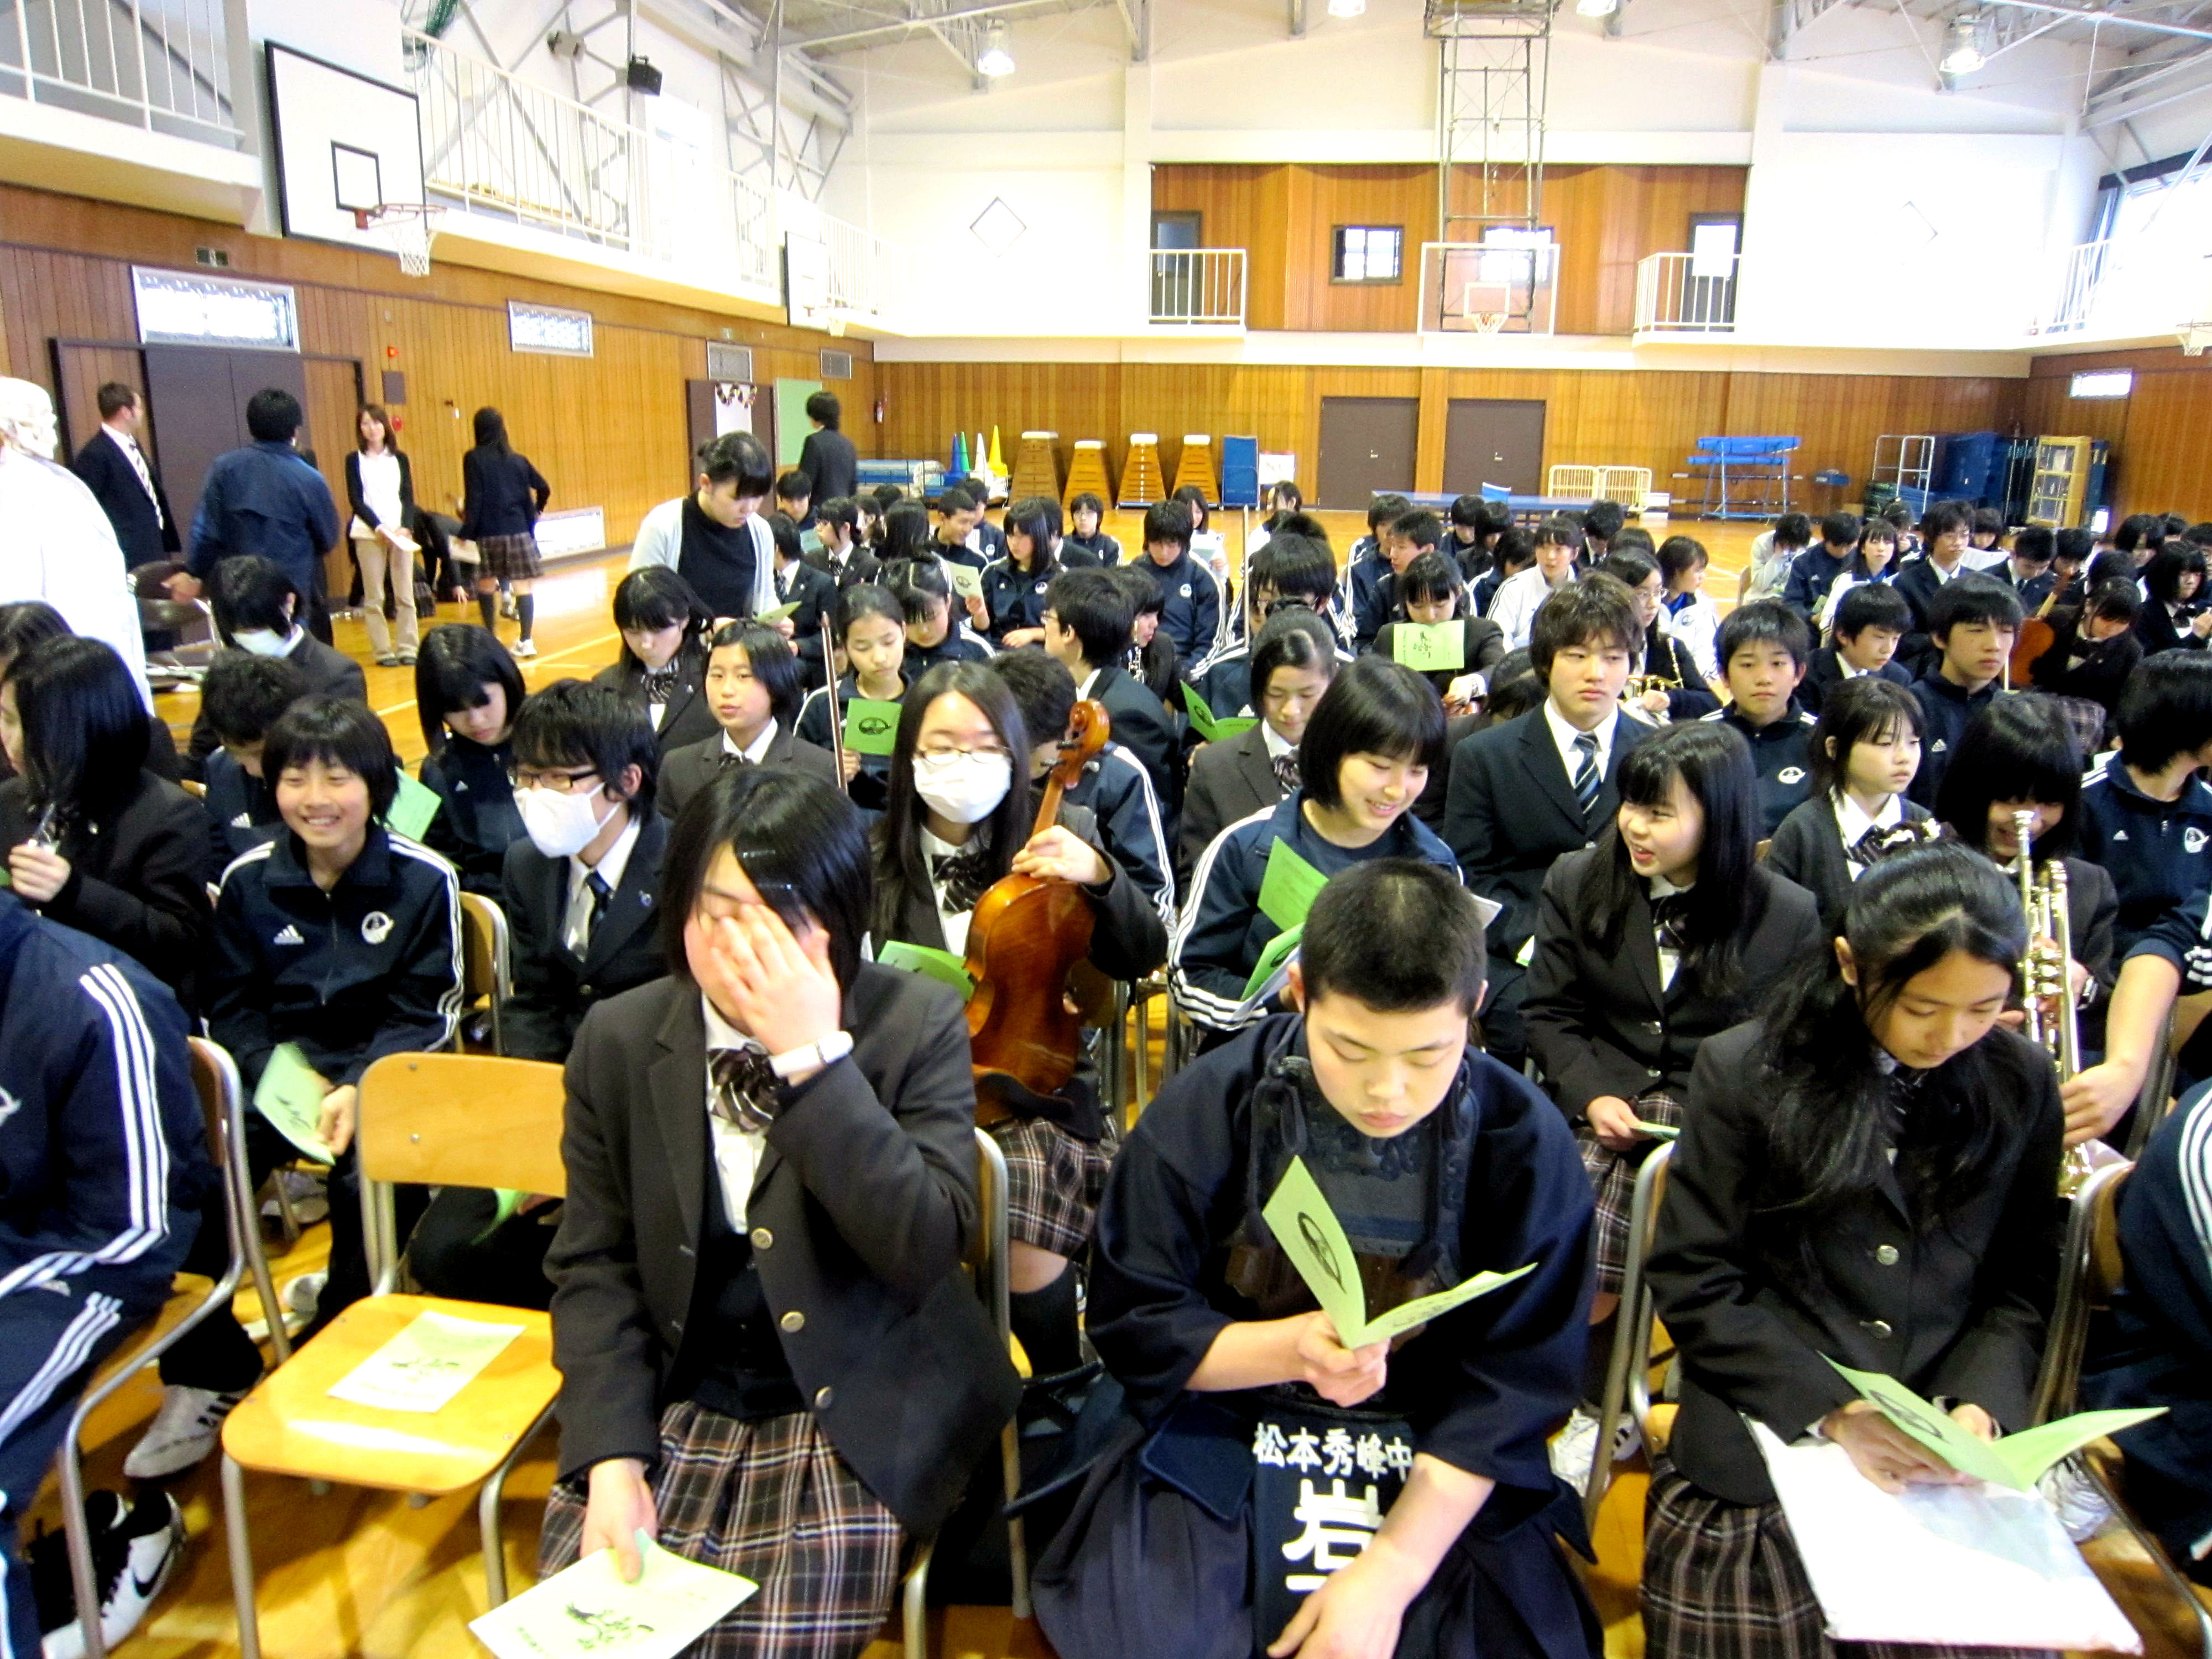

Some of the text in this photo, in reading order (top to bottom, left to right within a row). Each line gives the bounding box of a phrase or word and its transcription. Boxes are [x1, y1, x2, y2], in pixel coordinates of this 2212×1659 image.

[1253, 1422, 1413, 1482] 松本秀峰中
[1281, 1478, 1384, 1591] 岩
